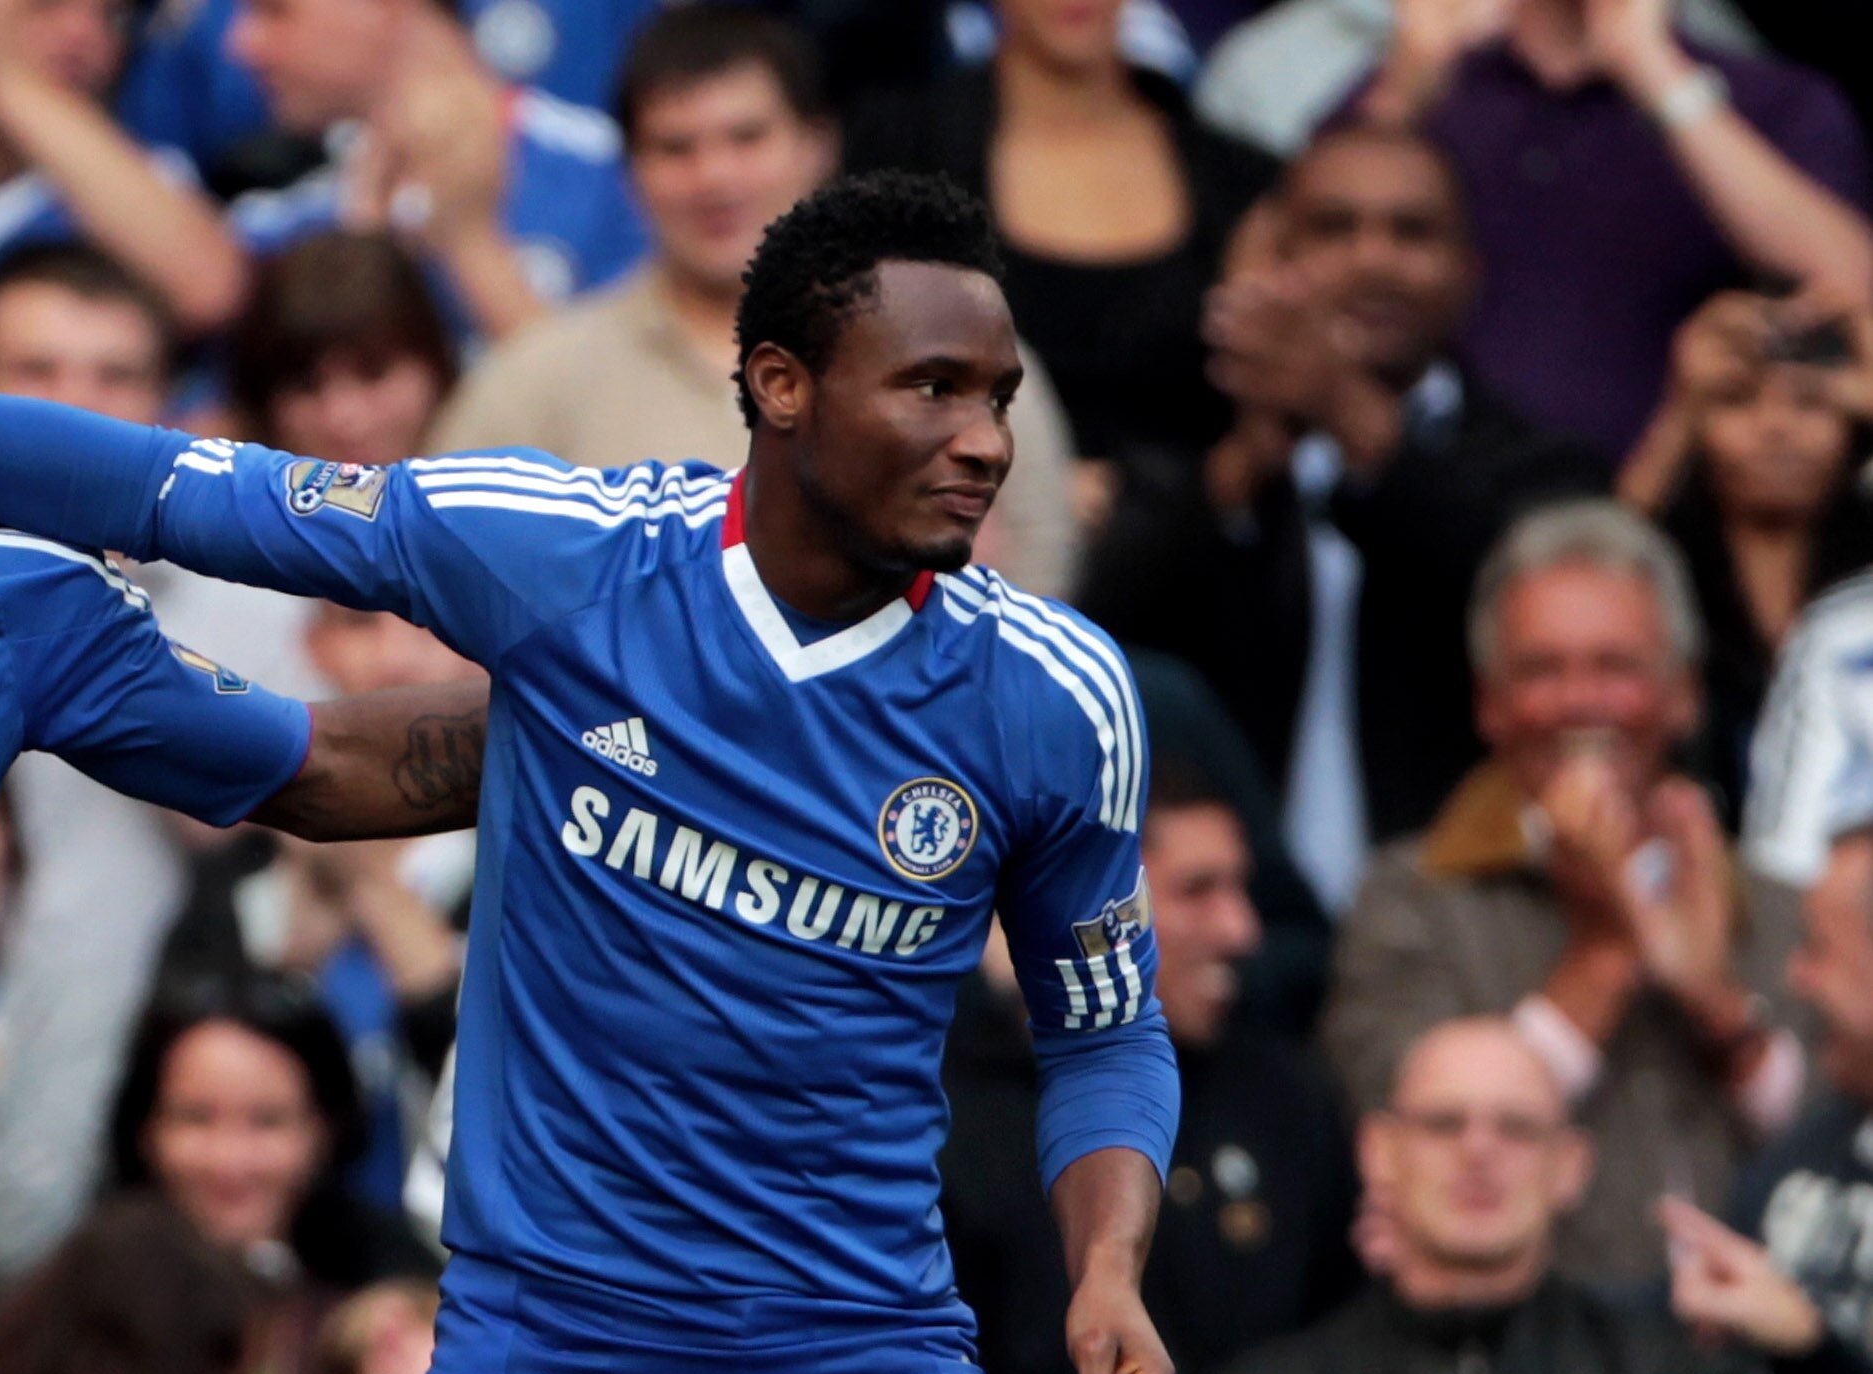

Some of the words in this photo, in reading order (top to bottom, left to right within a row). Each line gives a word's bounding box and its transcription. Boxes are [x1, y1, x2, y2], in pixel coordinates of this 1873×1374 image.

[581, 730, 658, 777] adidas
[901, 786, 962, 809] CHELSEA
[561, 785, 946, 956] SAMSUNG
